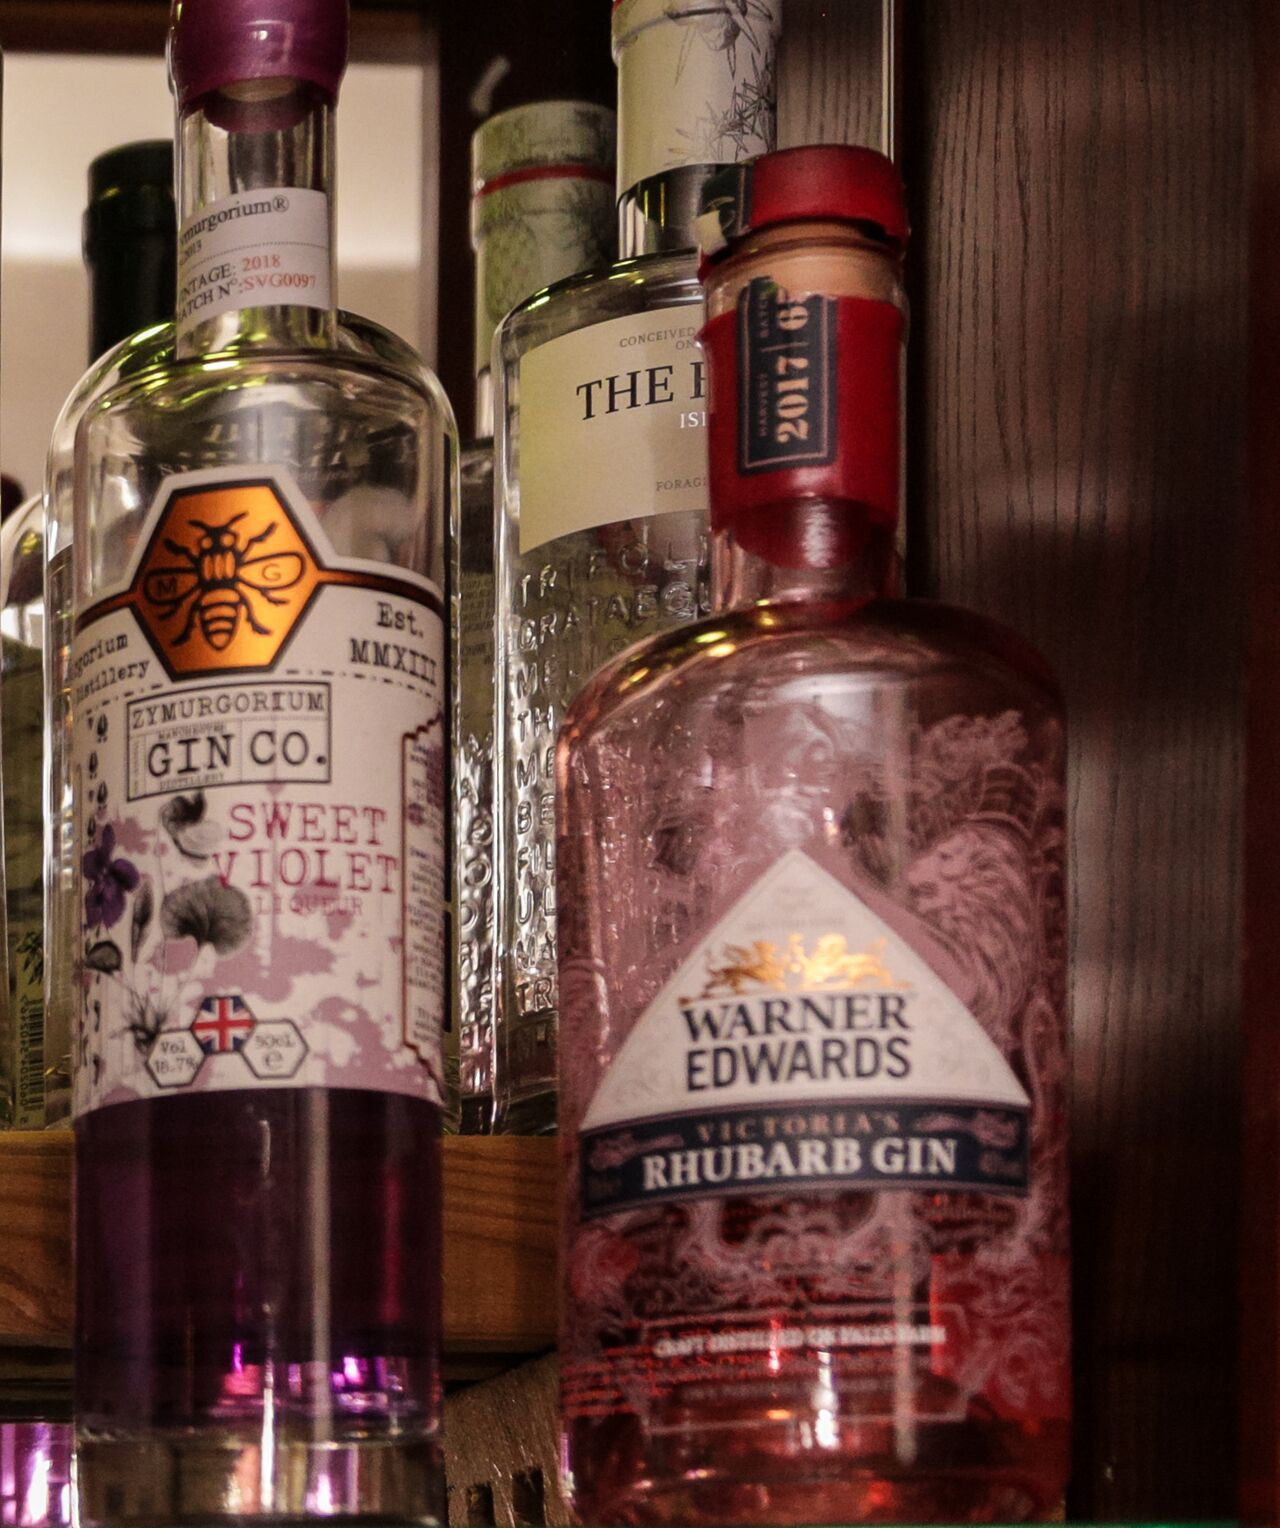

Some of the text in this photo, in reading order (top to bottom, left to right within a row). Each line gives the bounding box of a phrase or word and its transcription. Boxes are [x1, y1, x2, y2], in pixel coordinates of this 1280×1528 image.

[242, 254, 282, 272] 2018
[619, 326, 697, 349] CONCEIVED
[575, 365, 675, 421] THE
[774, 355, 810, 444] 2017
[375, 601, 425, 639] Est.
[348, 638, 439, 689] MMXIII
[132, 691, 326, 731] ZYMURGORIUM
[148, 734, 235, 778] GIN
[249, 730, 329, 766] CO.
[228, 801, 387, 846] SWEET
[211, 848, 399, 893] VIOLET
[681, 994, 912, 1043] WARNER
[686, 1035, 912, 1093] EDWARDS
[696, 1110, 902, 1143] VICTORIA'S
[643, 1137, 863, 1190] RHUBARB
[870, 1137, 958, 1176] GIN
